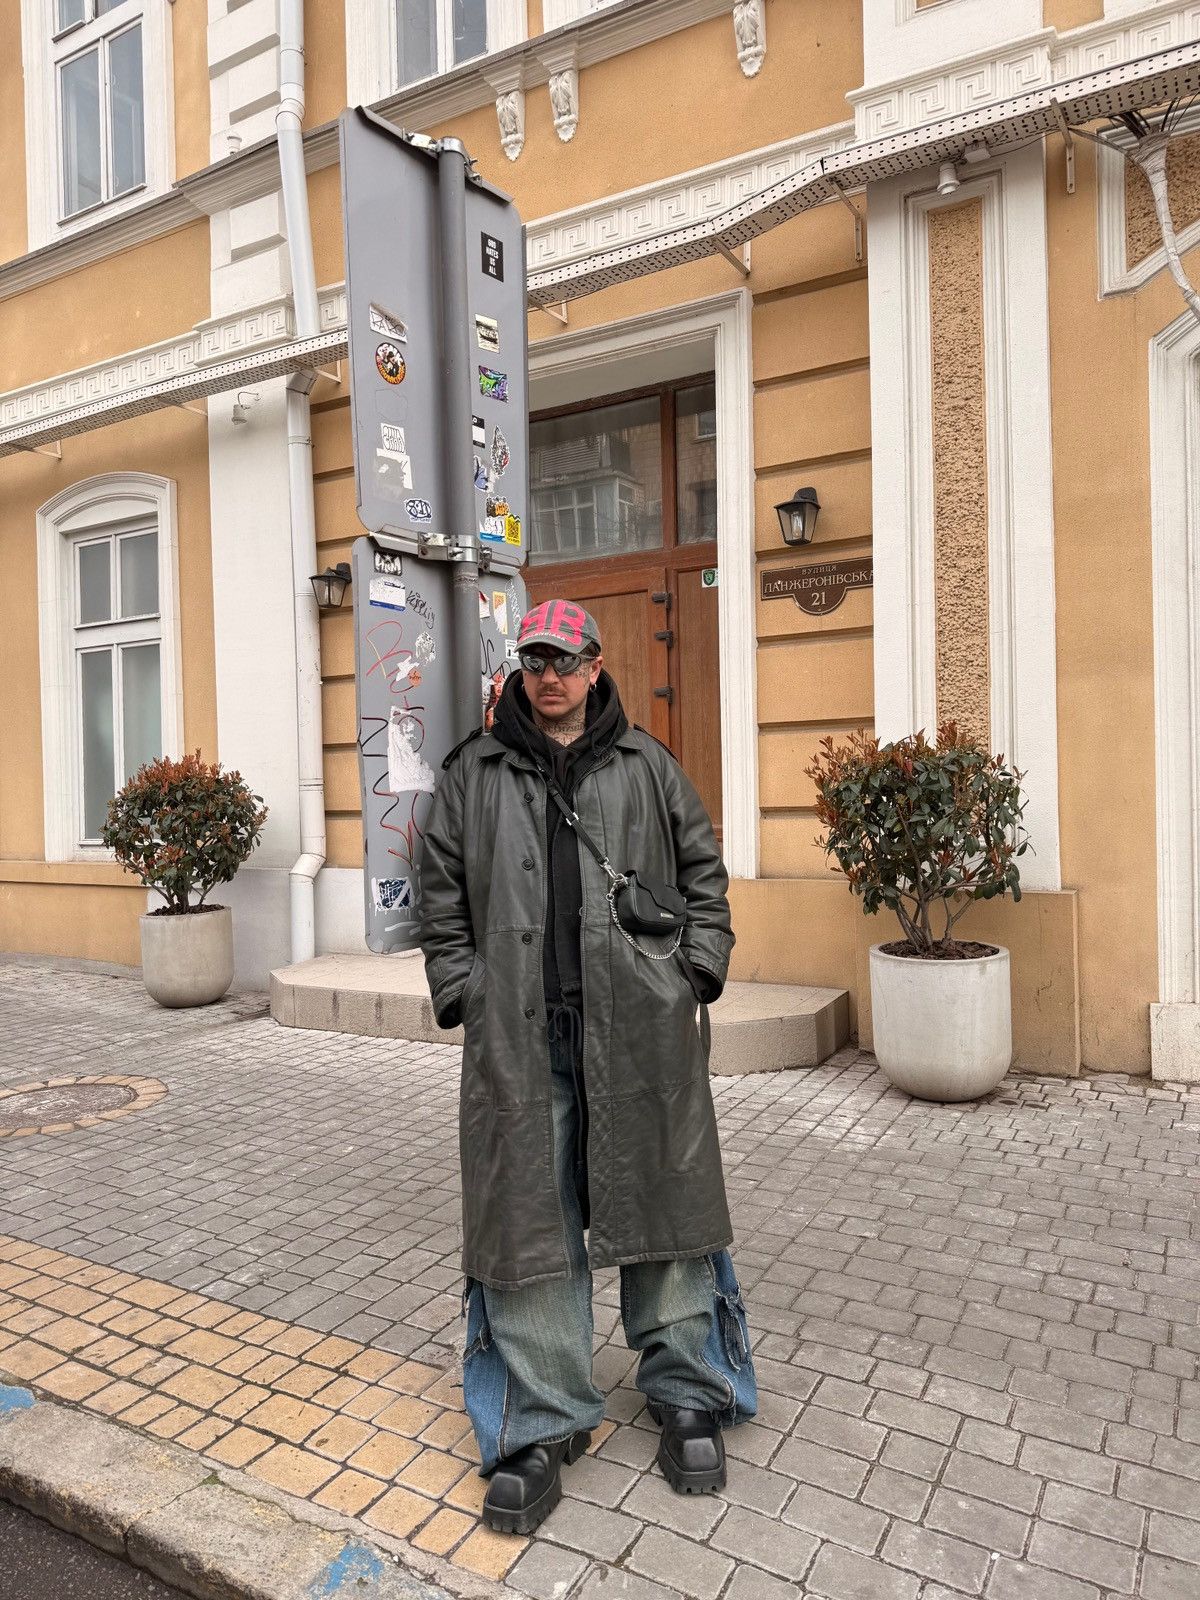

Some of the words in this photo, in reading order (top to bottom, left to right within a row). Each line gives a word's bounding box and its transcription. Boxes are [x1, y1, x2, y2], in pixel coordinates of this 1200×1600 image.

[486, 246, 499, 259] HATES
[801, 565, 837, 575] ВУЛИЦЯ
[811, 591, 826, 606] 21
